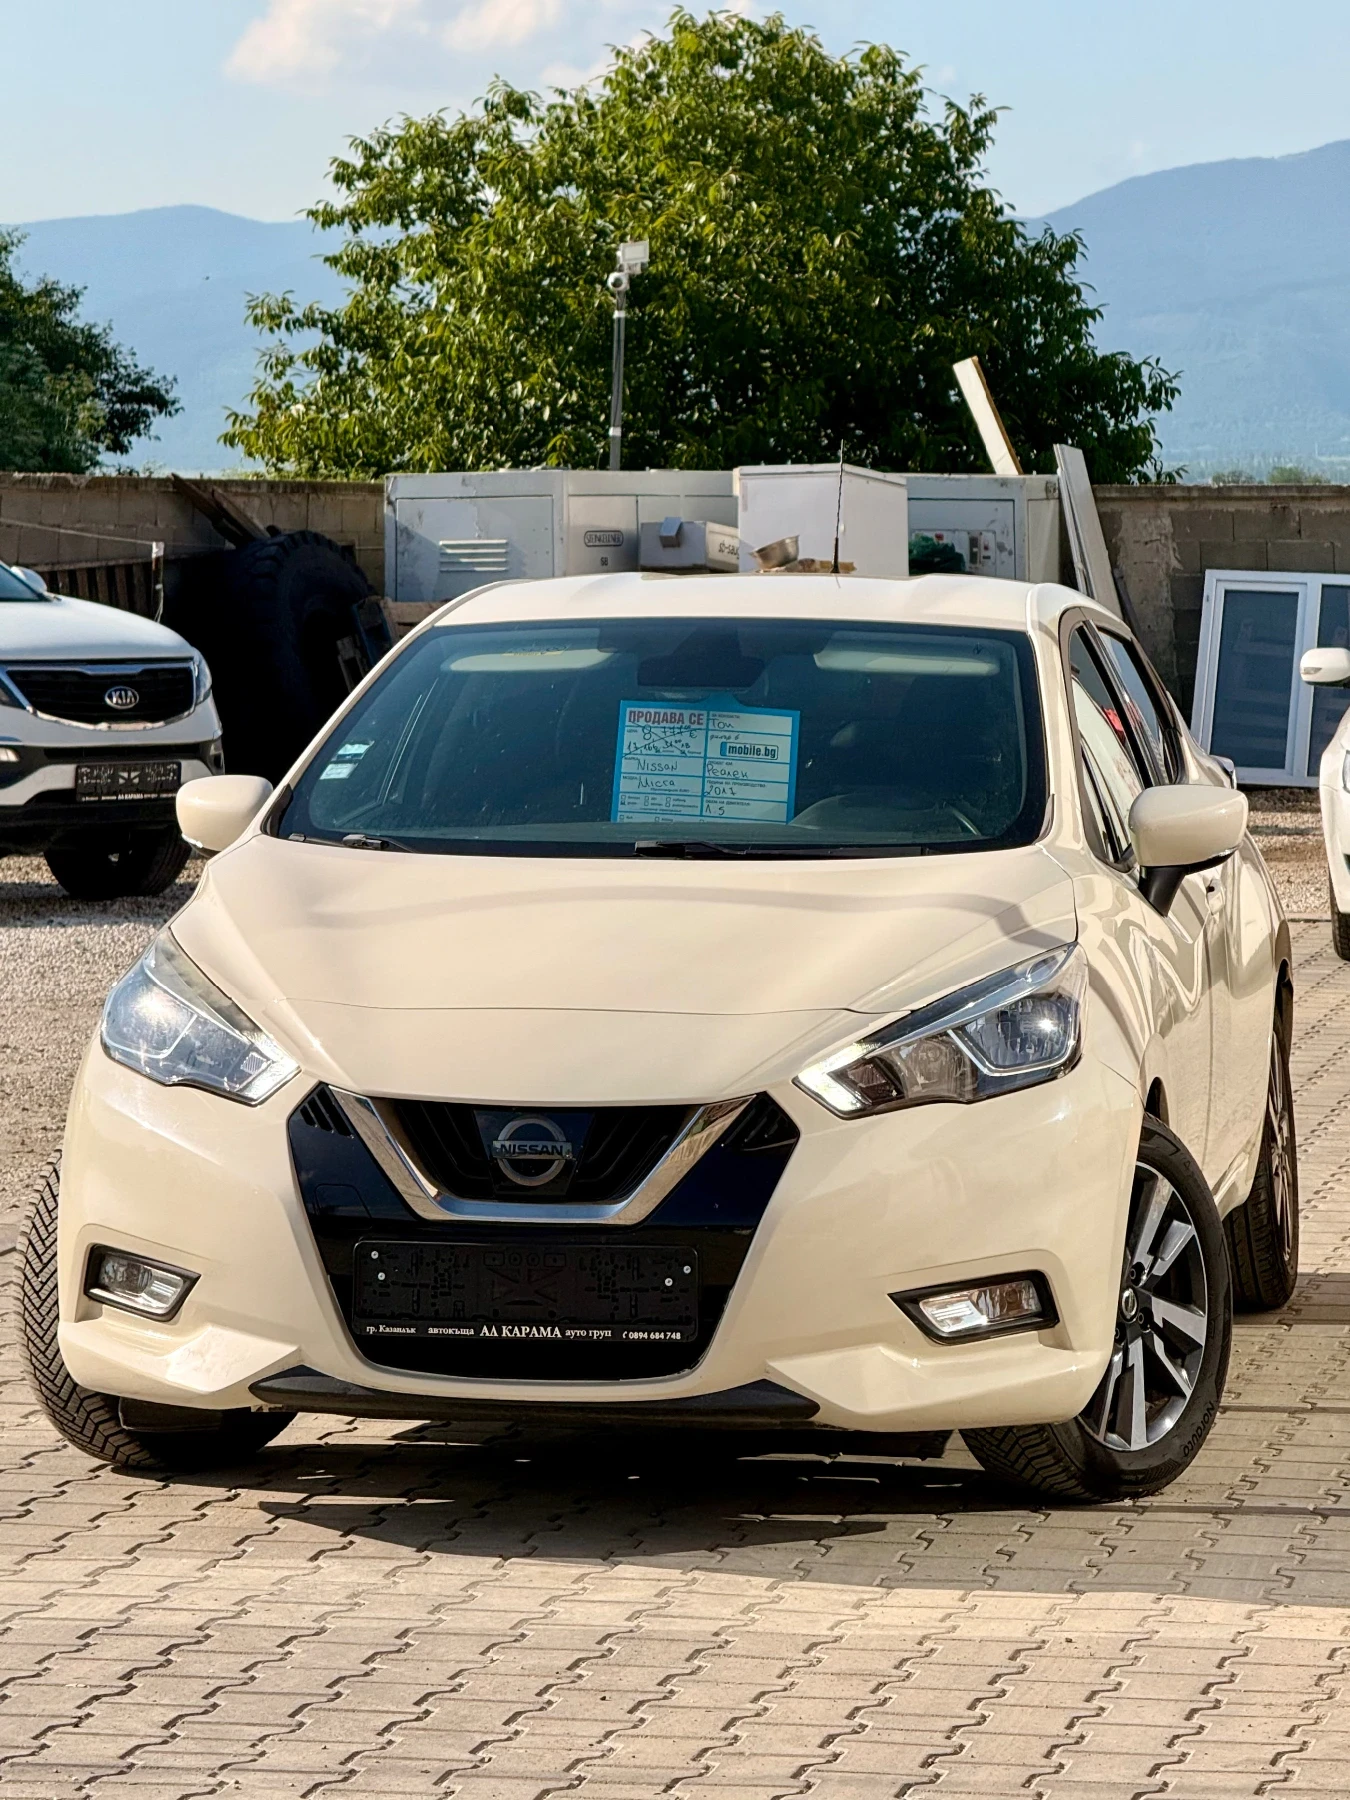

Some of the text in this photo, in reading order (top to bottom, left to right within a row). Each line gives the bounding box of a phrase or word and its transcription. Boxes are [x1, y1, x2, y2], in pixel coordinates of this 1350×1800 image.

[112, 690, 135, 704] KIA
[628, 710, 704, 725] ПРОДАВА СЕ
[728, 745, 776, 759] mobile.bg
[500, 1144, 564, 1156] NISSAN
[428, 1326, 475, 1337] автокъща
[502, 1325, 562, 1338] КАРАМА
[565, 1328, 587, 1338] ауто
[589, 1329, 612, 1338] груп
[628, 1331, 682, 1341] 0894 684 748
